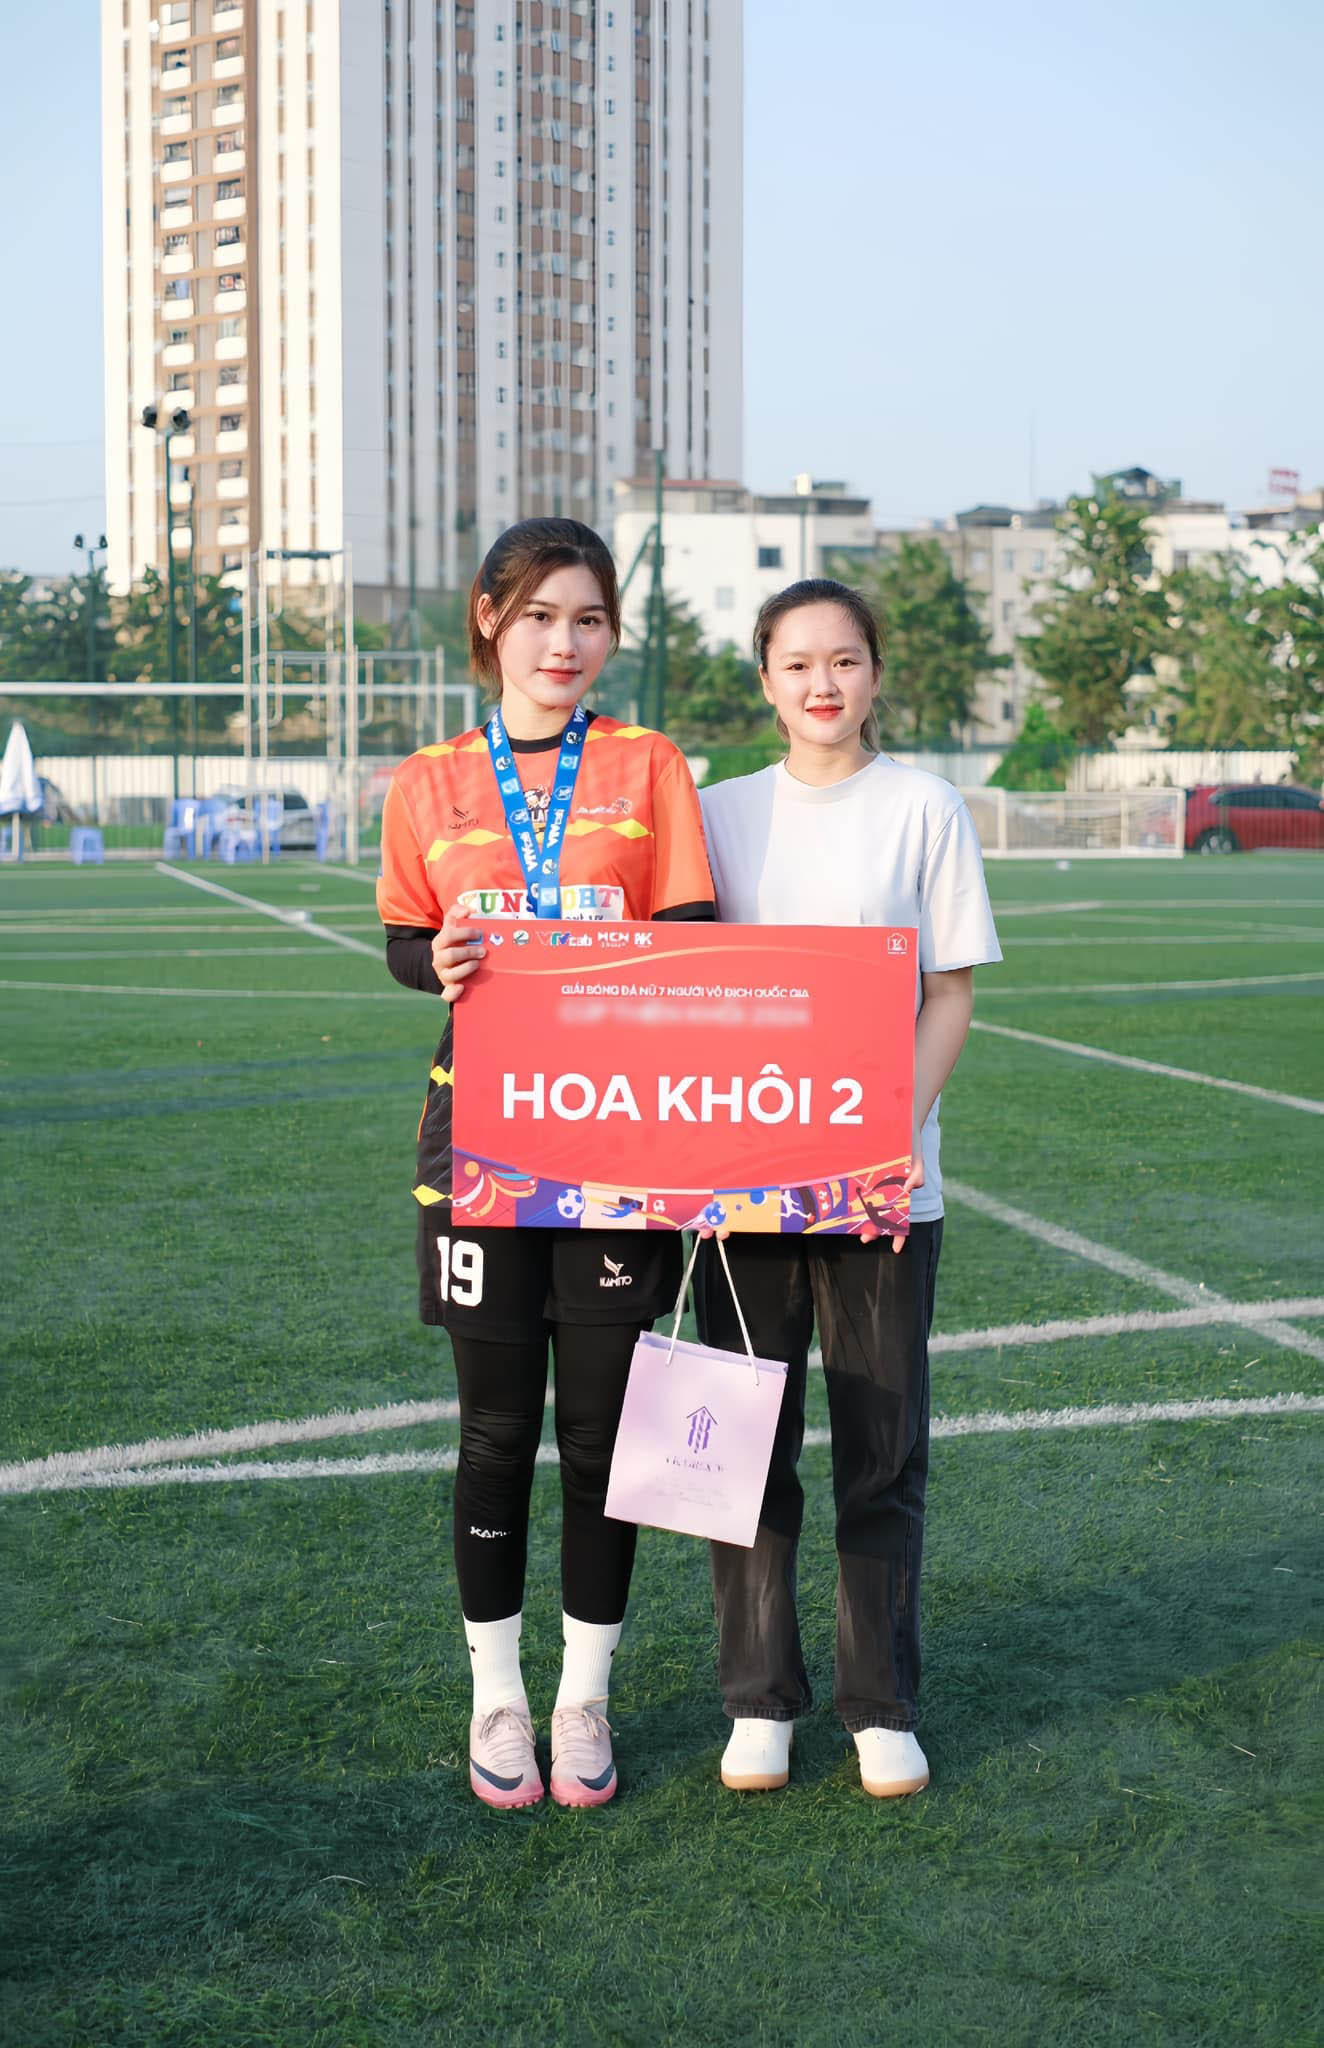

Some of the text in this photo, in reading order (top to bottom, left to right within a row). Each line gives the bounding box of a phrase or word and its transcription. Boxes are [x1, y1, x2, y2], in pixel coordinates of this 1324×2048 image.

[659, 986, 666, 996] 7
[789, 988, 809, 998] GIA
[503, 1064, 863, 1124] HOA KHÔI 2
[436, 1236, 484, 1307] 19
